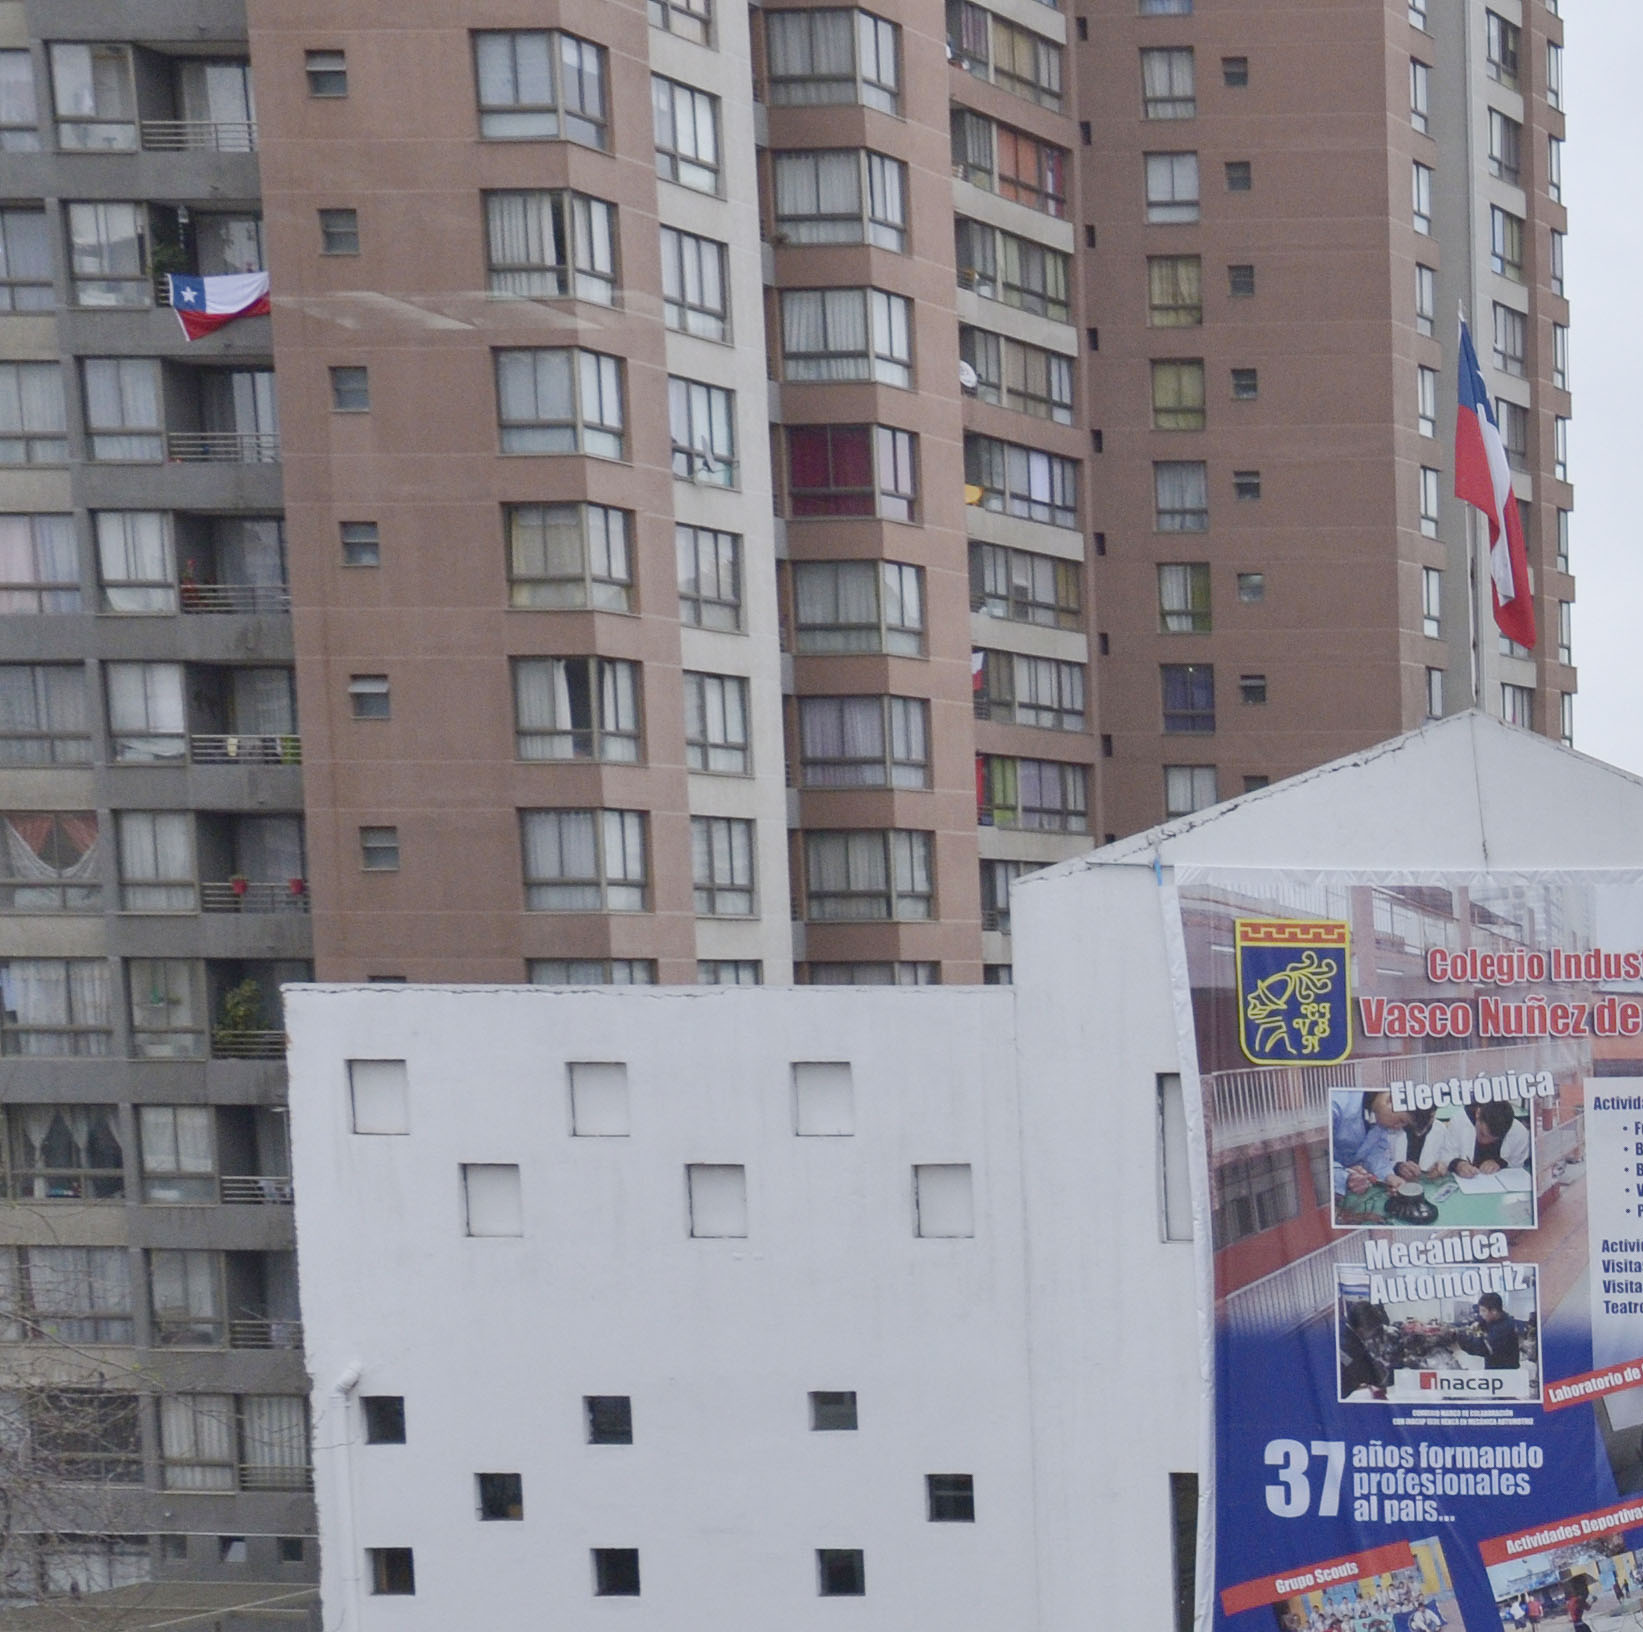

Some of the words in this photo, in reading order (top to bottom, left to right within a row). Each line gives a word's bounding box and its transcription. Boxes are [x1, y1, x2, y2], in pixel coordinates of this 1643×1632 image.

[1426, 946, 1545, 985] Colegio
[1360, 996, 1473, 1038] Vasco
[1479, 994, 1587, 1037] Nuñez
[1593, 994, 1641, 1037] de
[1390, 1070, 1555, 1112] Electrónica
[1364, 1230, 1509, 1270] Mecánica
[1370, 1261, 1527, 1305] Automotriz
[1548, 1371, 1623, 1403] Laboratorio
[1623, 1367, 1641, 1382] de
[1264, 1438, 1345, 1518] 37
[1352, 1440, 1414, 1468] años
[1418, 1442, 1544, 1469] formando
[1353, 1469, 1531, 1497] profesionales
[1354, 1496, 1378, 1522] al
[1505, 1523, 1581, 1554] Actividades
[1275, 1573, 1315, 1594] Grupo
[1314, 1562, 1359, 1584] Scouts
